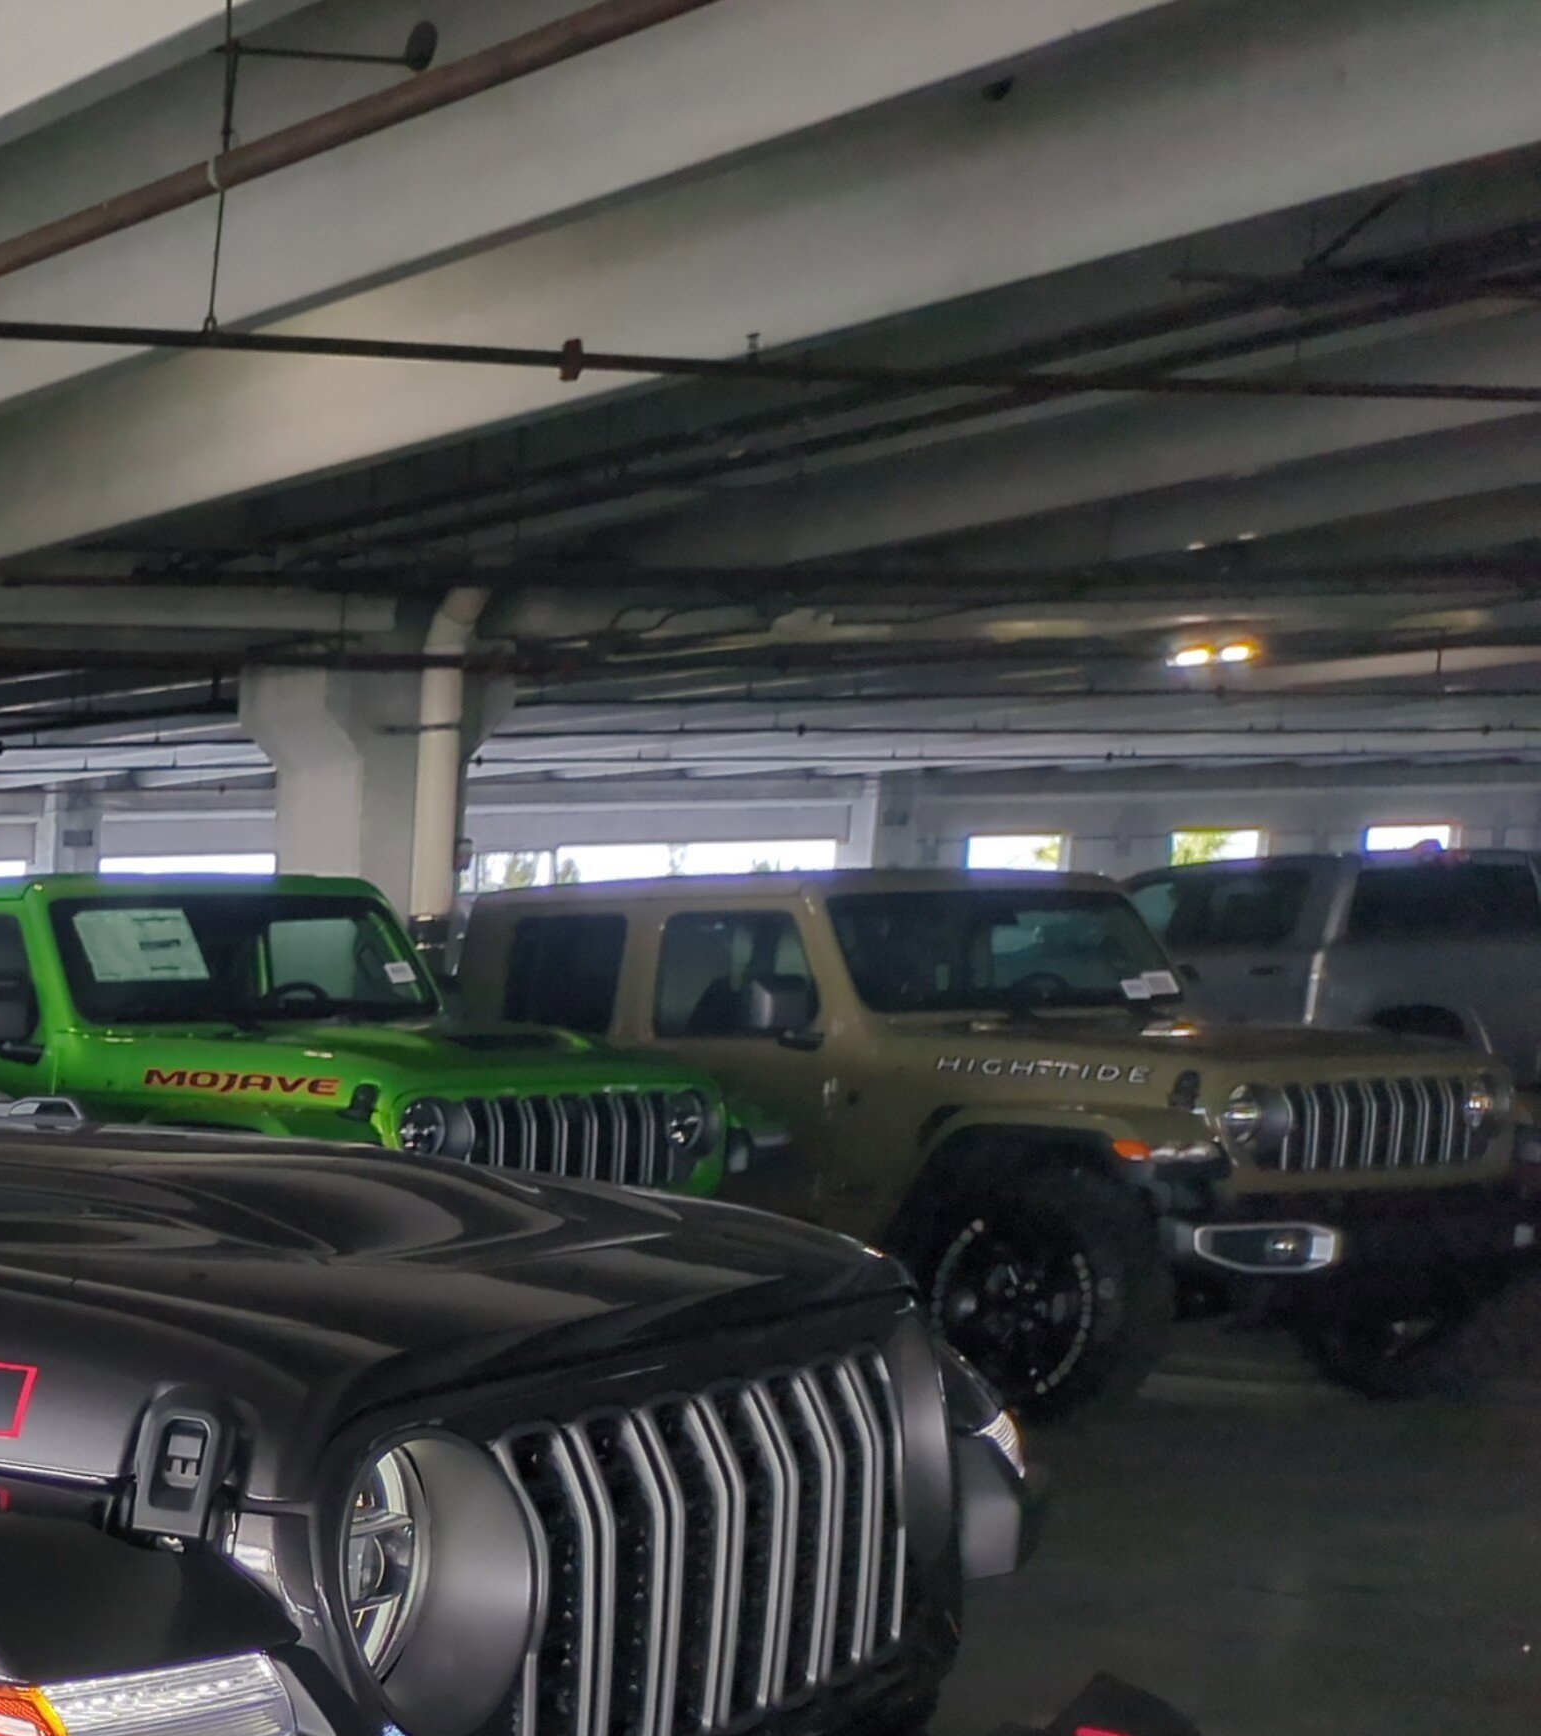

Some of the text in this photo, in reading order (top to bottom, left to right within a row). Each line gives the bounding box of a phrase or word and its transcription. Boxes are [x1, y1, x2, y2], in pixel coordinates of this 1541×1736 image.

[144, 1069, 340, 1096] MOJAVE
[936, 1055, 1151, 1083] HIGH TIDE
